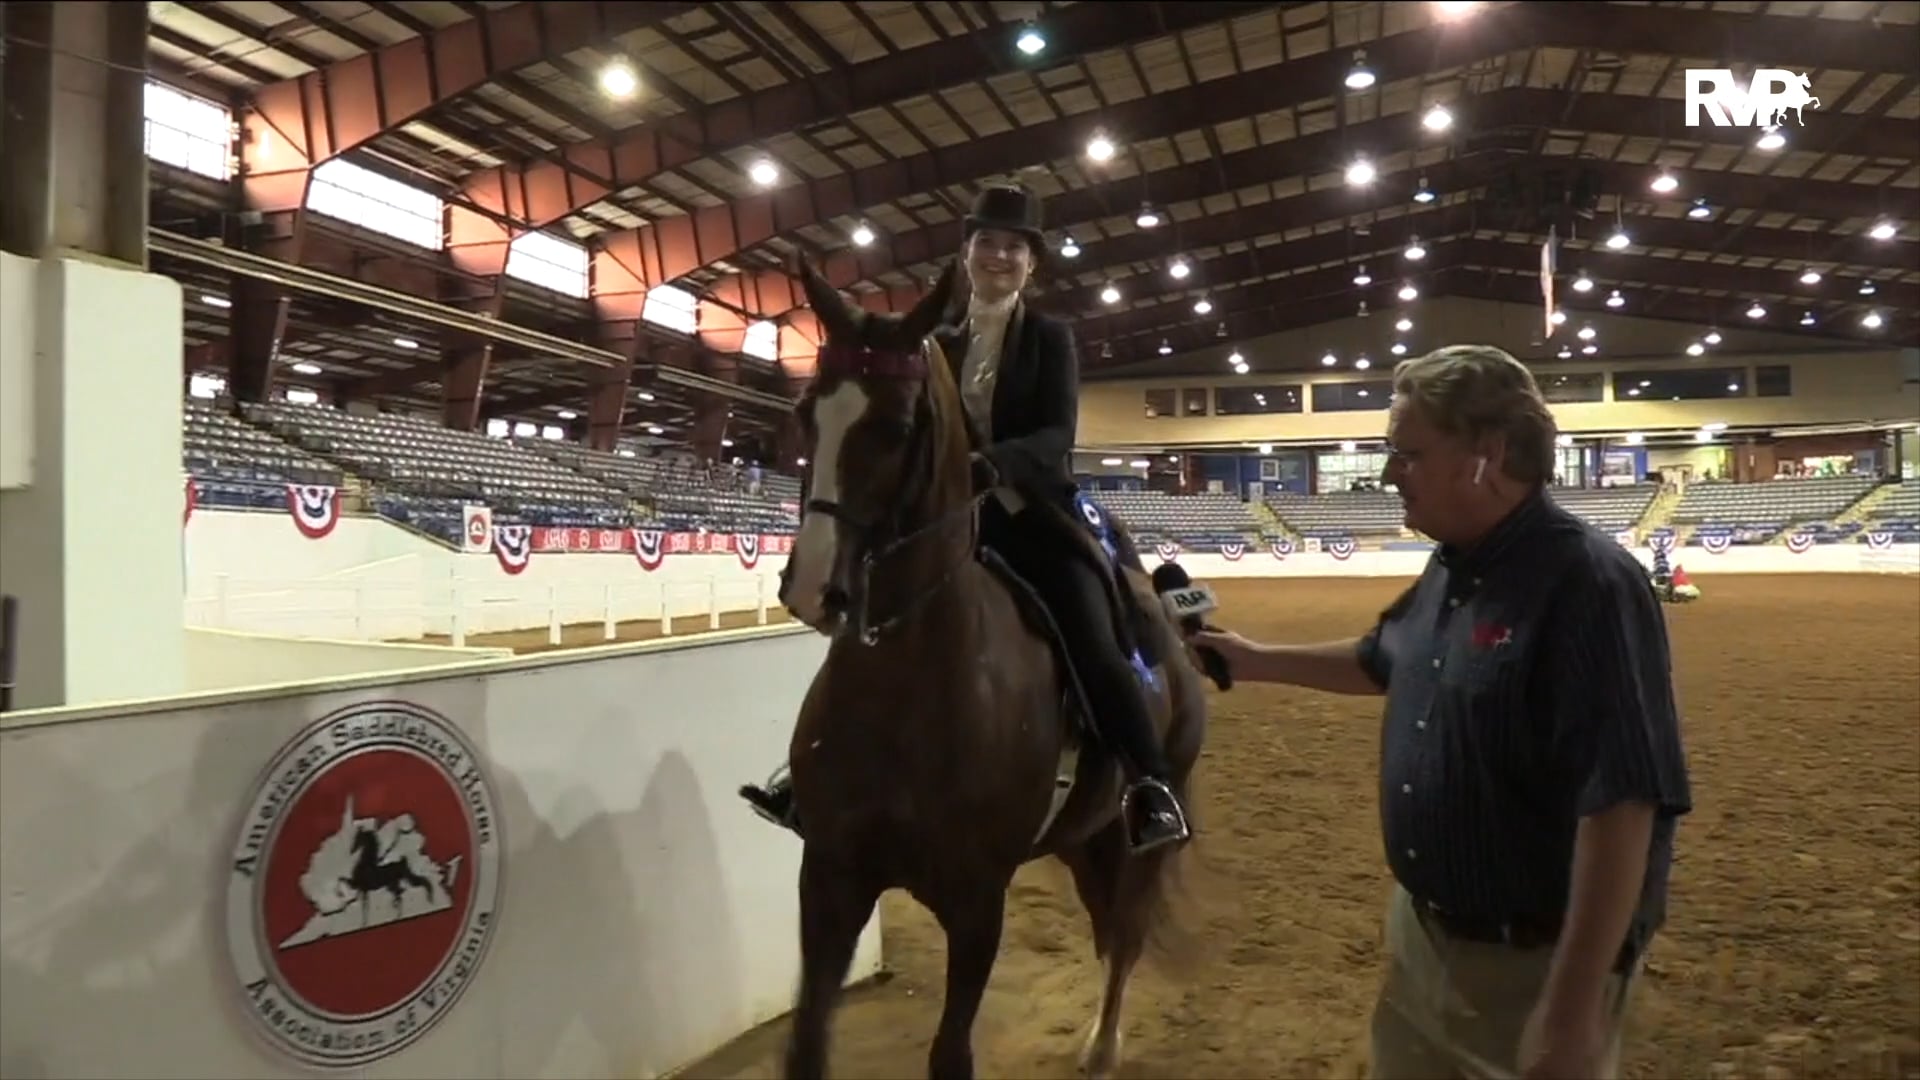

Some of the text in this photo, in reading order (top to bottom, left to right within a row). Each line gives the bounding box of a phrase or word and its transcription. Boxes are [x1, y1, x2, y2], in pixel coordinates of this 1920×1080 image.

[234, 715, 490, 877] American Saddlebred Horse
[246, 912, 491, 1050] Association of Virginia
